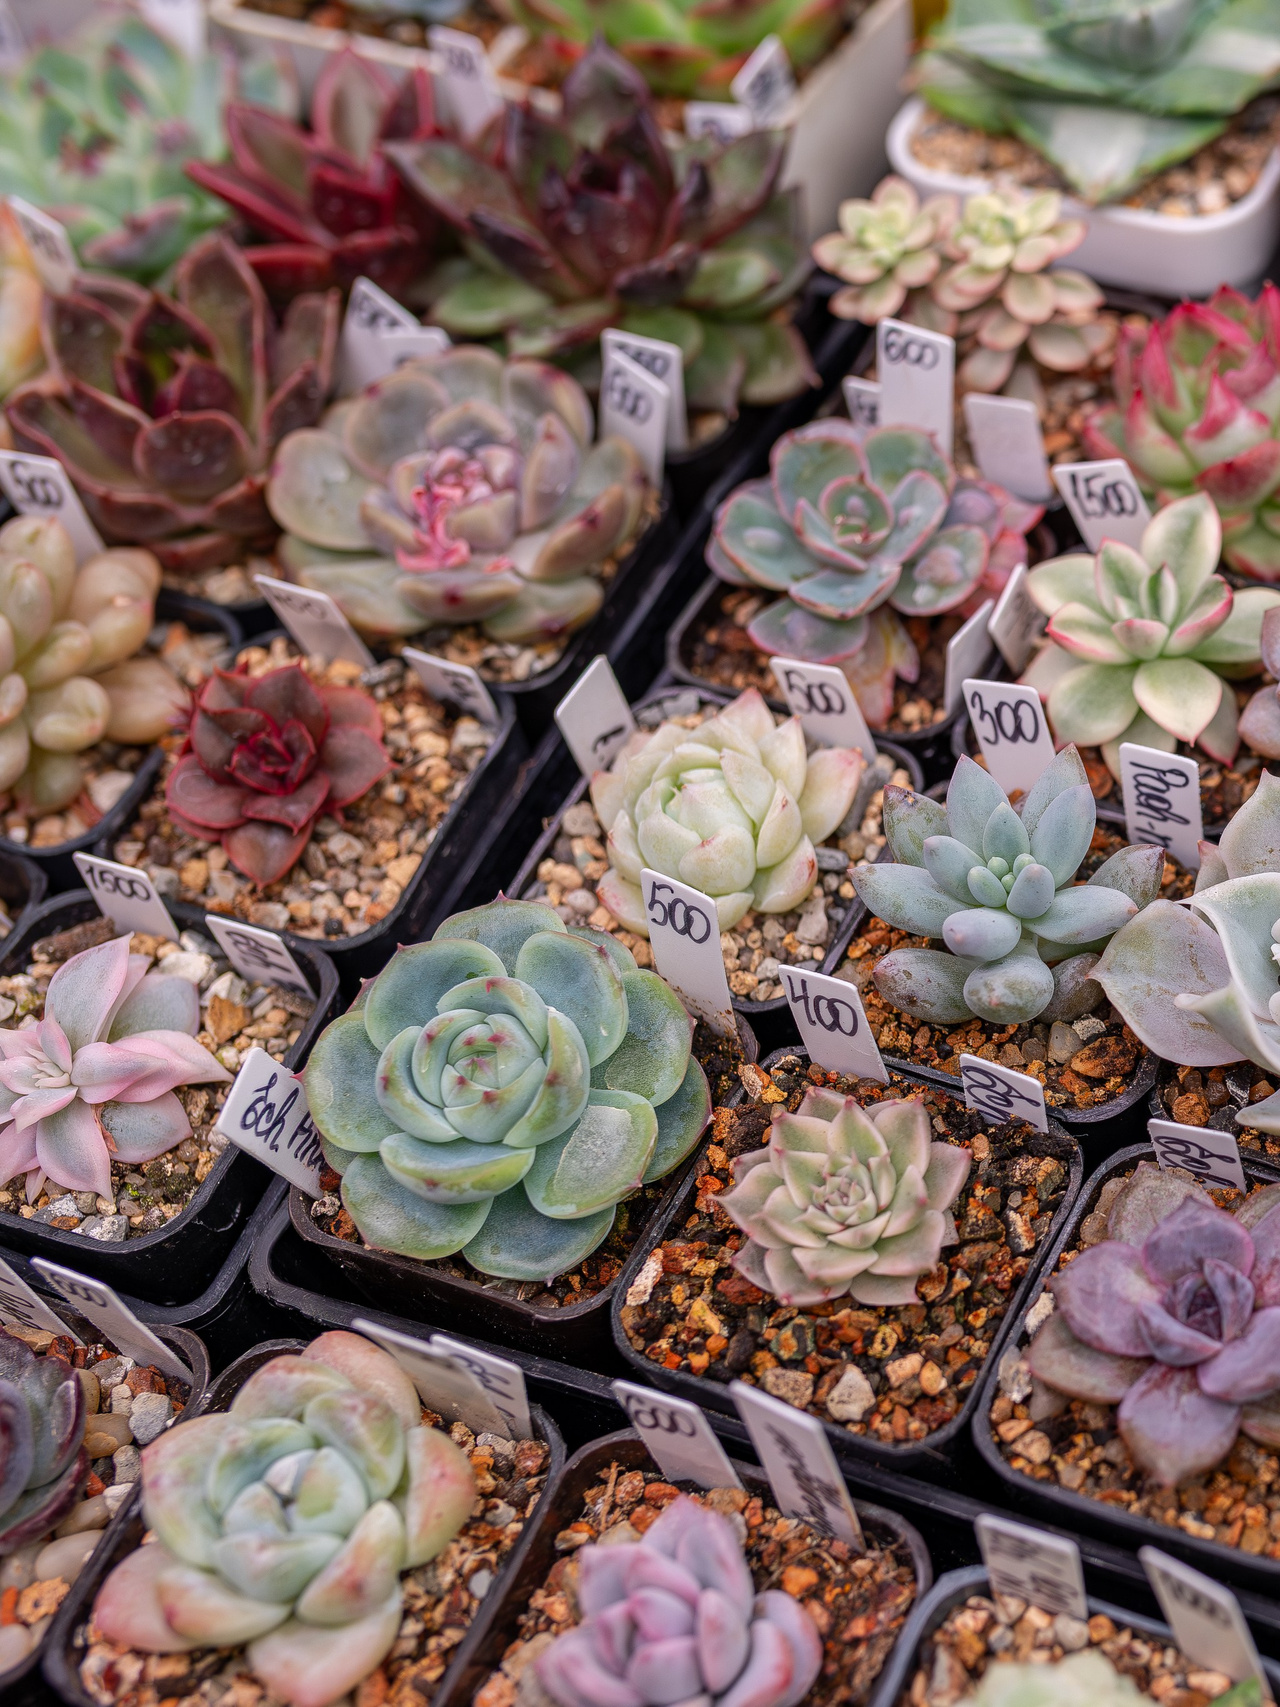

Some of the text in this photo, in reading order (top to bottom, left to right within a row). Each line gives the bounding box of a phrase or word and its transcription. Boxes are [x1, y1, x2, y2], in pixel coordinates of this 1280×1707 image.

[884, 327, 939, 370] 600
[1069, 471, 1137, 518] 1500
[784, 669, 845, 715] 500
[971, 691, 1039, 745] 300
[85, 864, 151, 901] 1500
[648, 881, 711, 945] 500
[786, 974, 858, 1037] 400
